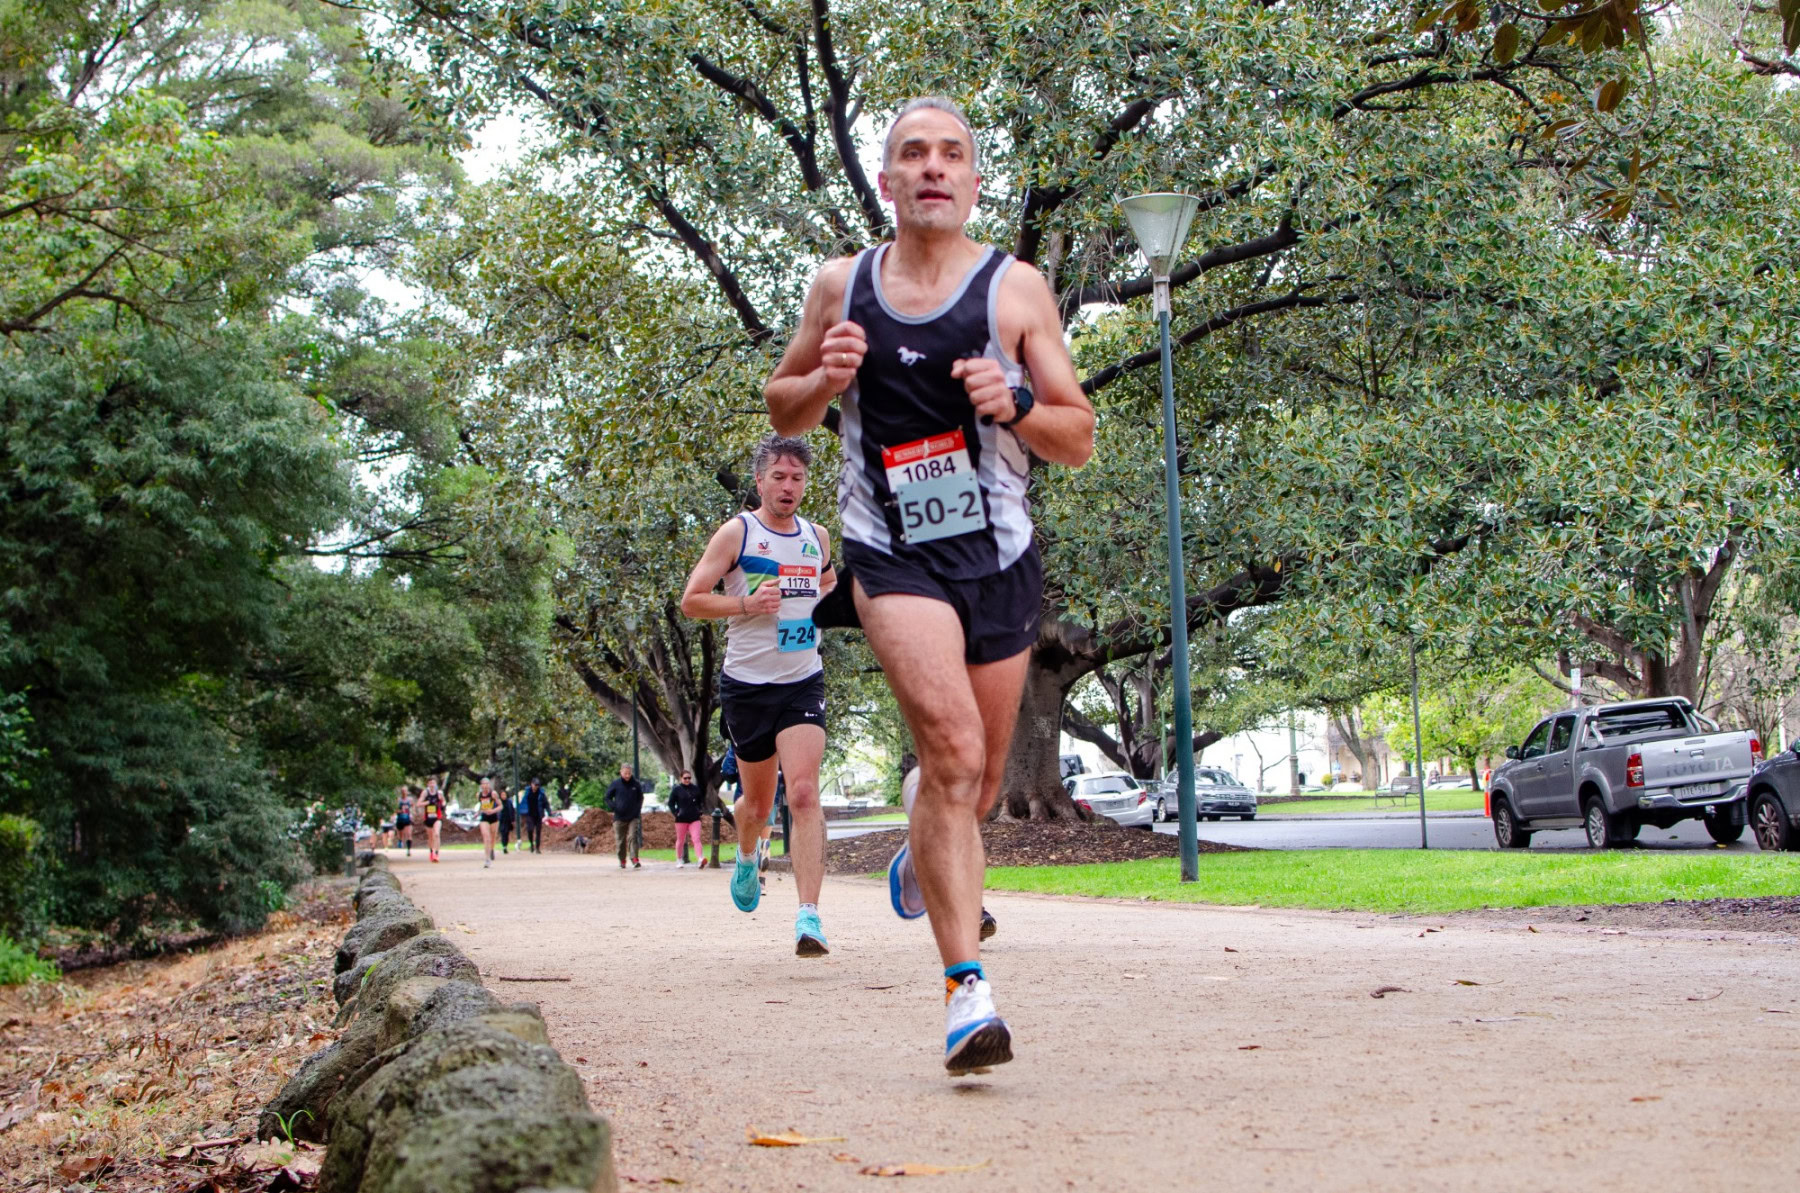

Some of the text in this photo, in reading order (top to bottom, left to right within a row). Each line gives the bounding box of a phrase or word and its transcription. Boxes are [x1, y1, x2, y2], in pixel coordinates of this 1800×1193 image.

[903, 456, 956, 483] 1084
[904, 491, 980, 529] 50-2
[787, 577, 810, 588] 1178
[778, 626, 815, 646] 7-24
[1665, 757, 1734, 777] TOYOTA
